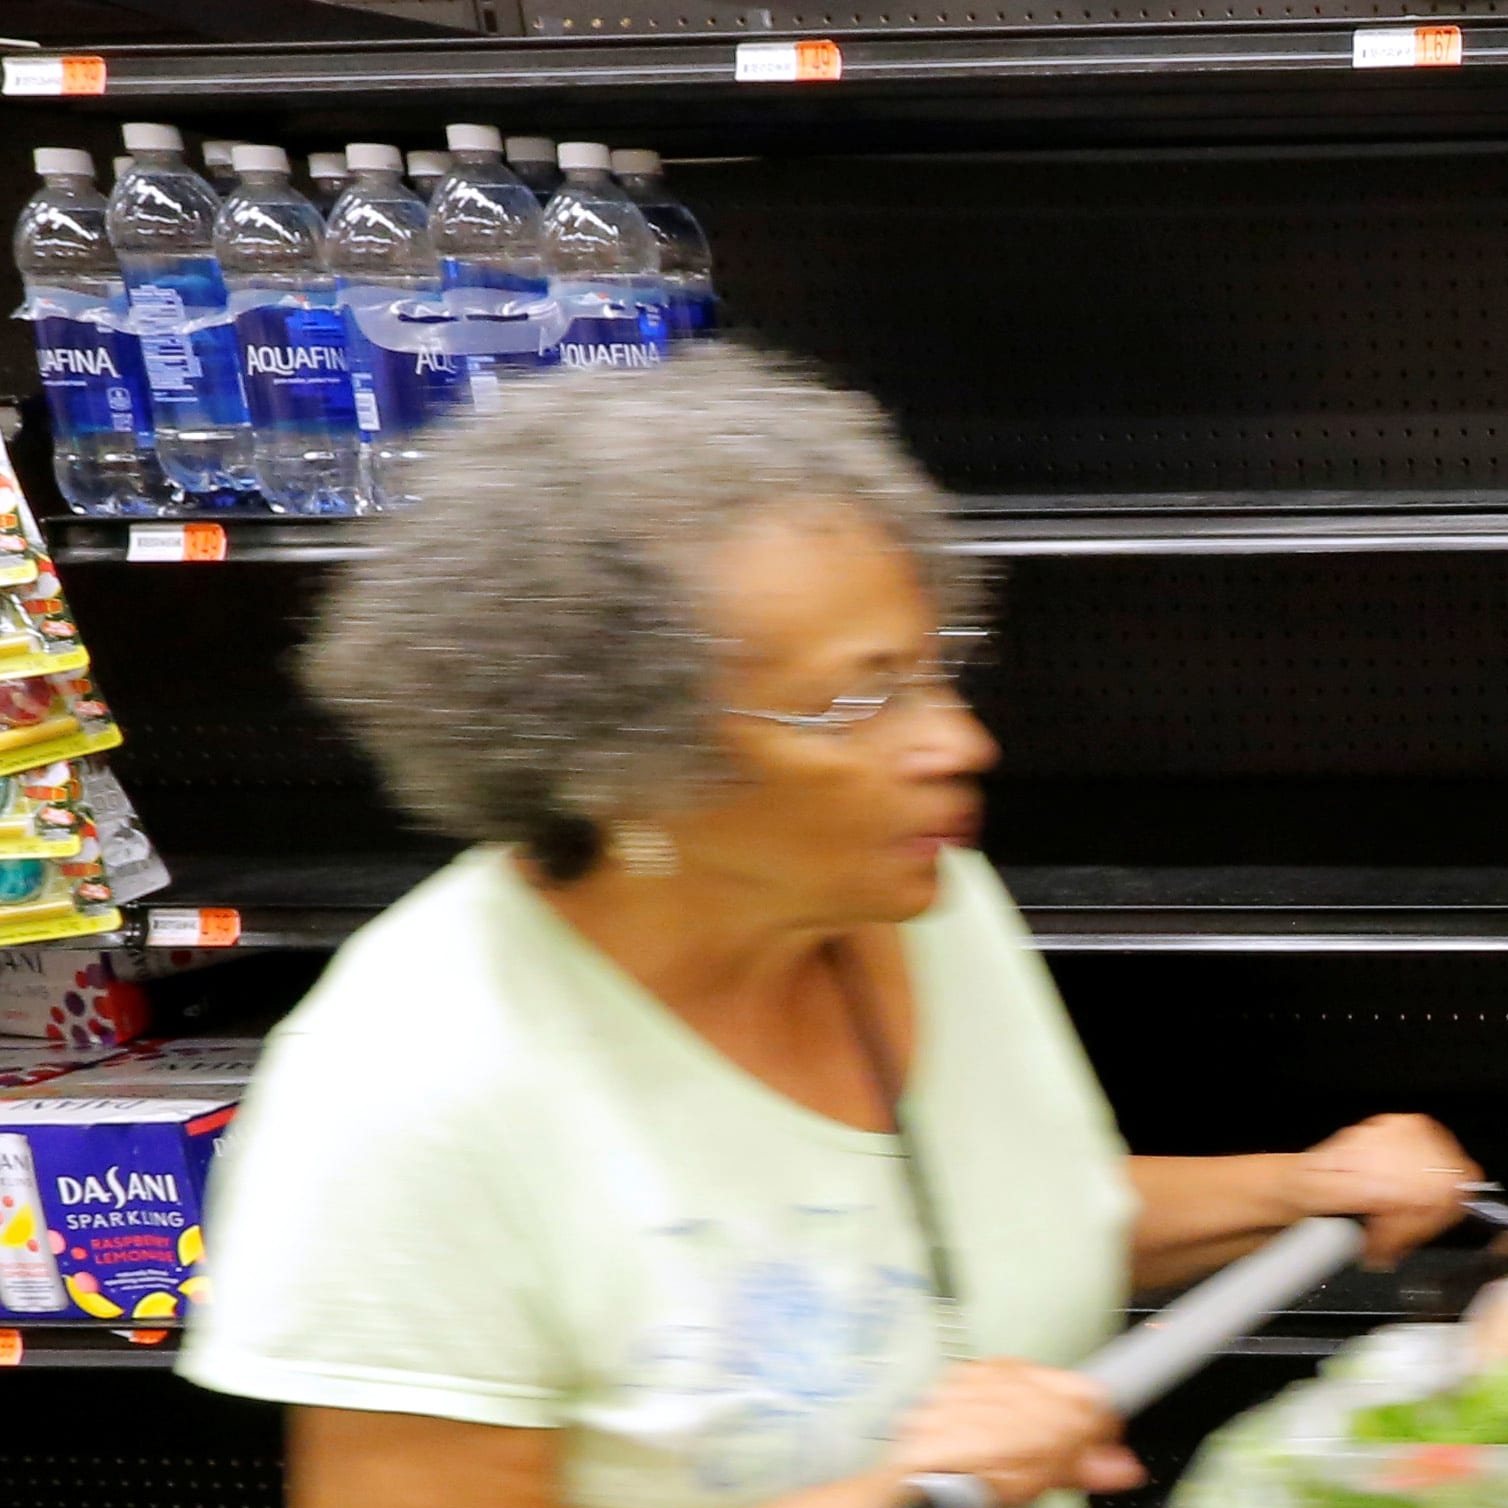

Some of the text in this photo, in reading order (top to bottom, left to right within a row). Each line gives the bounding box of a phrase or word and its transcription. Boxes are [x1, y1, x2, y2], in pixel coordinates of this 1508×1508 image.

[39, 347, 122, 379] AFINA
[246, 344, 349, 377] AQUAFIN
[56, 1165, 178, 1209] DASANI
[66, 1210, 185, 1230] SPARKLING
